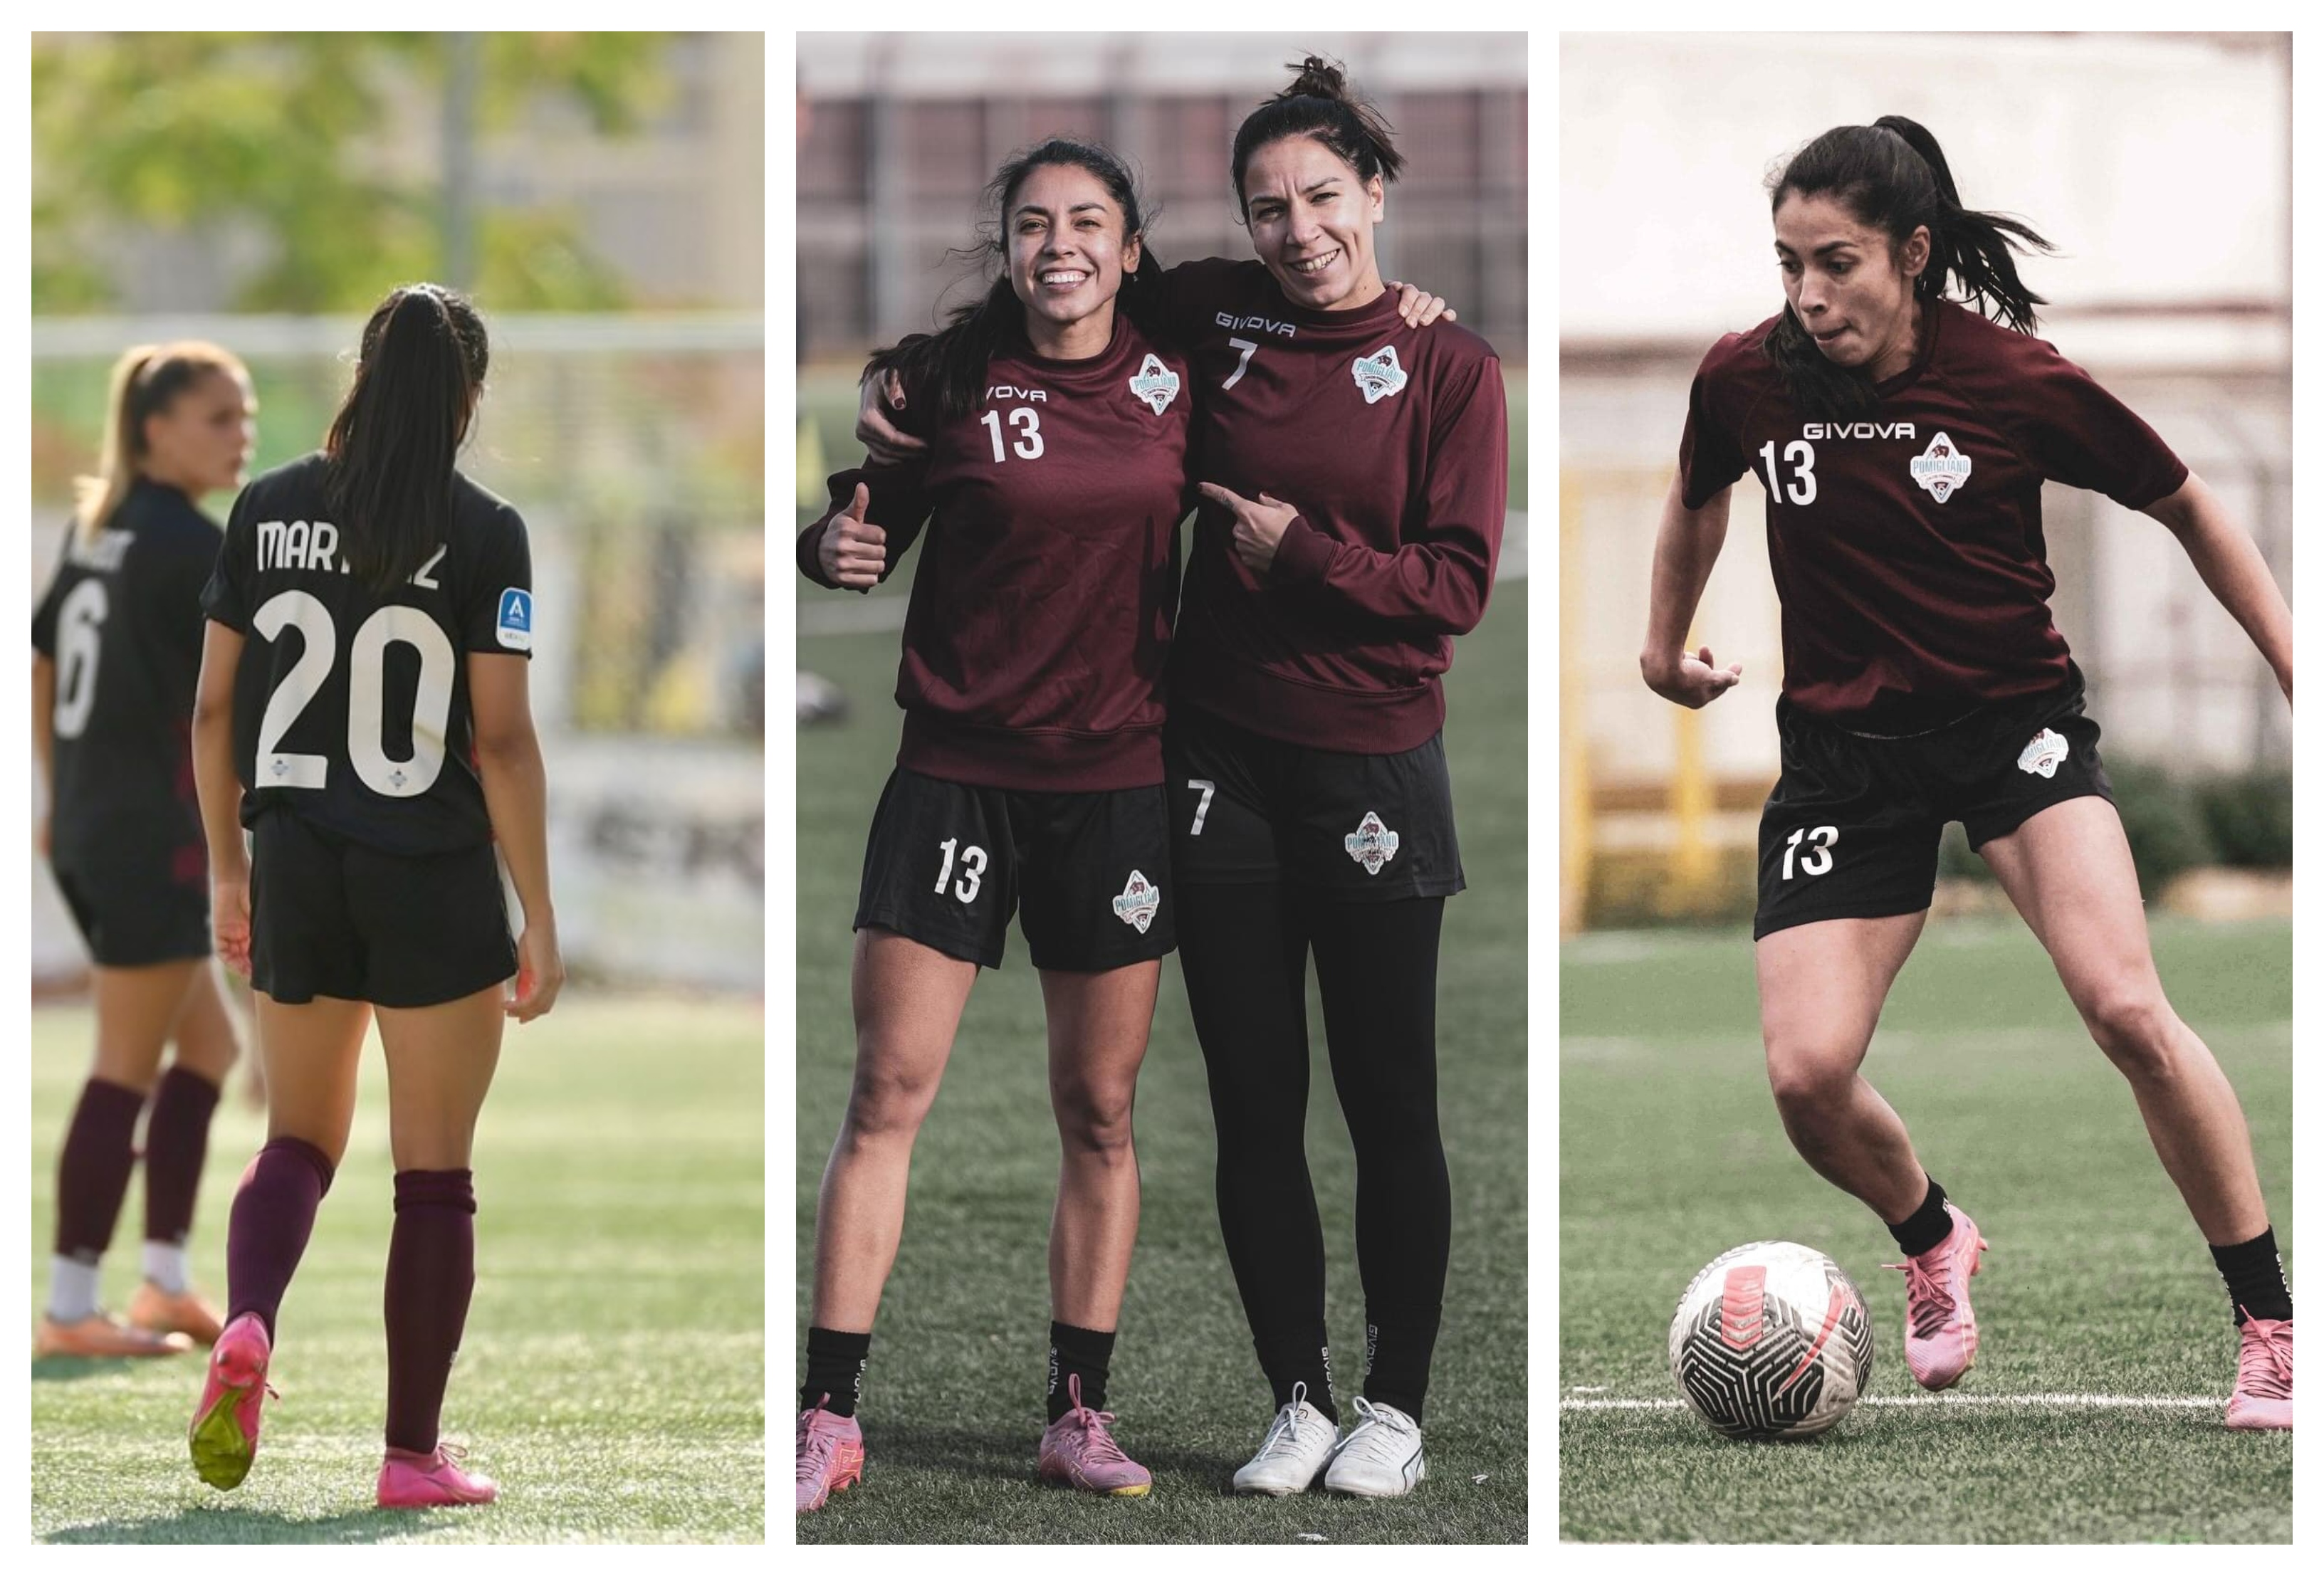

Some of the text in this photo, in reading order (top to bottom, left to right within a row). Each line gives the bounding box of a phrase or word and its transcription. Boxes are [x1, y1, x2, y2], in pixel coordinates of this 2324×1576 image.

[1215, 312, 1296, 337] GIVOVA
[1222, 337, 1258, 391] 7
[985, 386, 1047, 402] VOVA
[980, 407, 1044, 463] 13
[1804, 423, 1915, 439] GIVOVA
[1759, 441, 1816, 505] 13
[1913, 460, 1968, 473] POMIGLIANO
[256, 520, 447, 590] MARZ
[54, 578, 108, 739] 6
[253, 589, 454, 797] 20
[1188, 780, 1215, 836] 7
[934, 837, 988, 903] 13
[1782, 826, 1839, 880] 13
[1114, 888, 1158, 912] POMIGLIA
[1321, 1347, 1334, 1405] GIVOV
